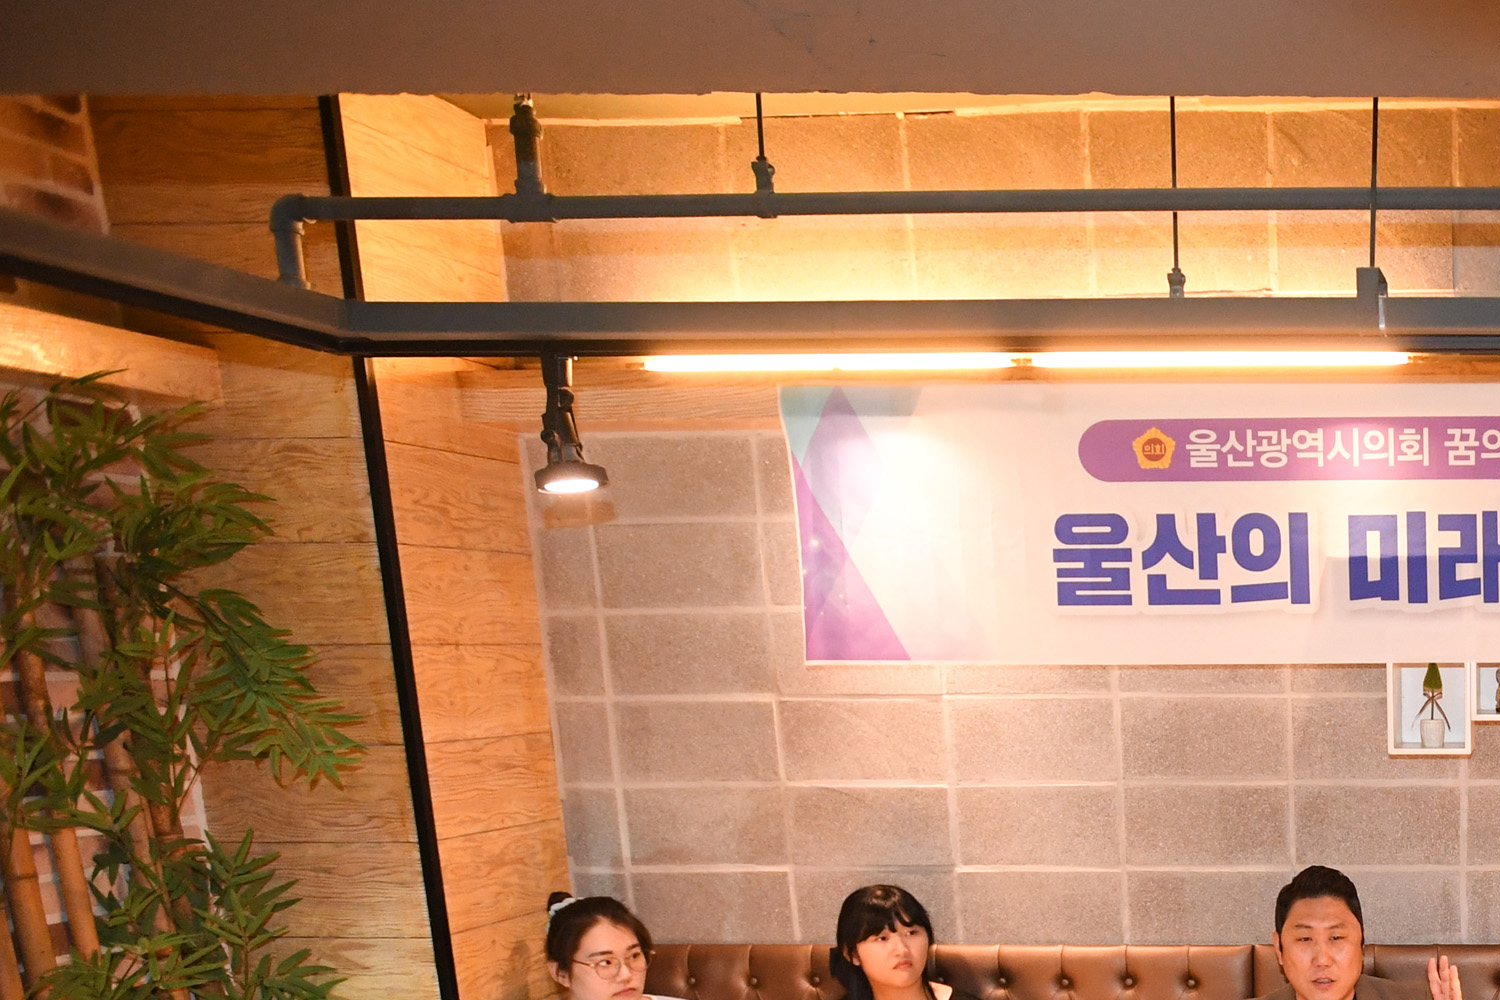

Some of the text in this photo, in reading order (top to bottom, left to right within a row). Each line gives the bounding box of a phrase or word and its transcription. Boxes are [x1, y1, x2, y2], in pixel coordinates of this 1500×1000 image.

[1143, 443, 1165, 455] 의회
[1185, 427, 1430, 468] 울산광역시의회
[1052, 512, 1311, 606] 울산의
